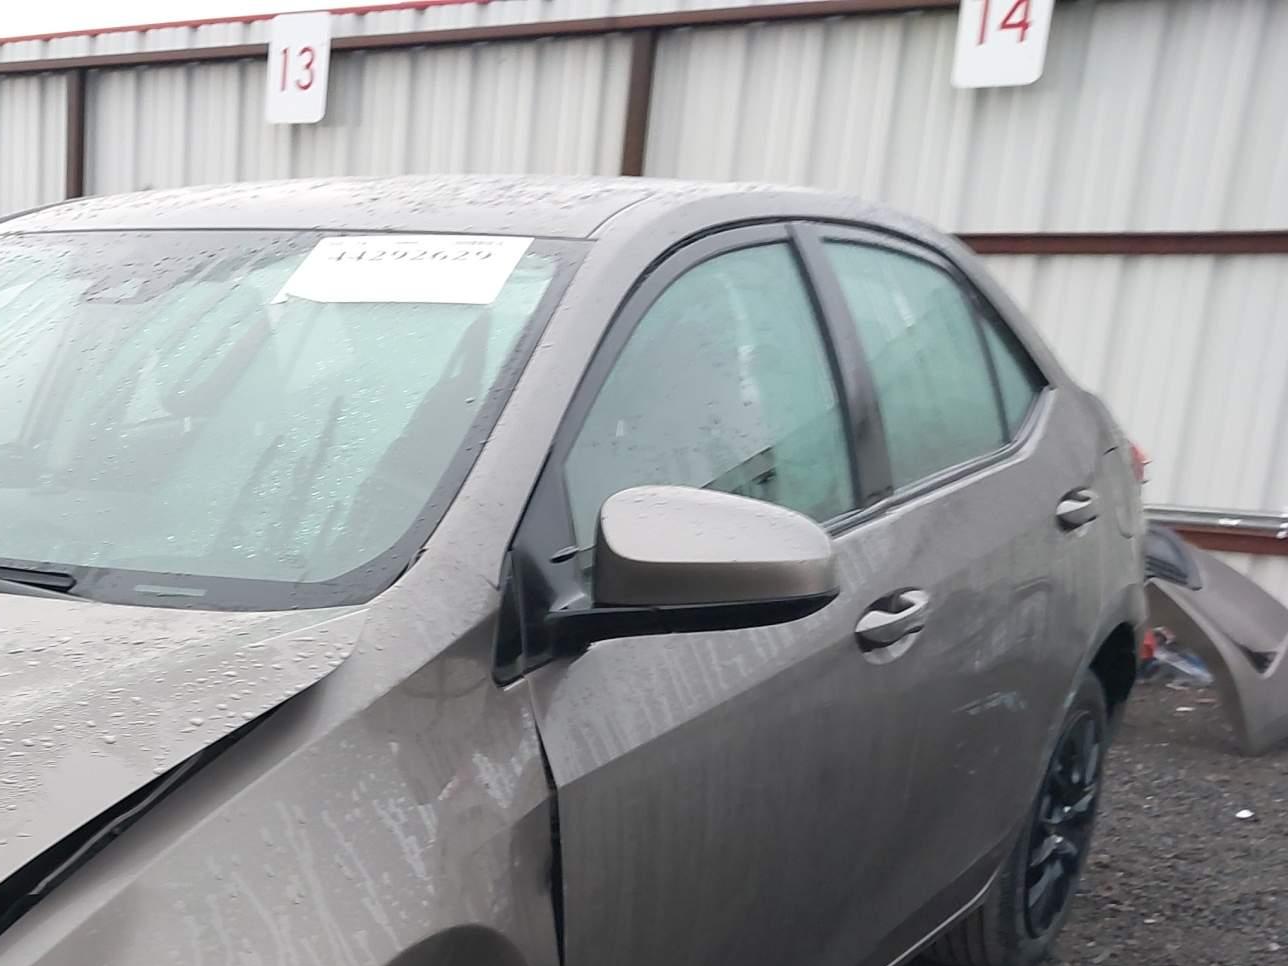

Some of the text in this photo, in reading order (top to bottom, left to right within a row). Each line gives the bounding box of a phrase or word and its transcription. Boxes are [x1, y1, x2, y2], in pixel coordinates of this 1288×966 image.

[977, 0, 1031, 45] 14
[280, 46, 316, 91] 13
[327, 249, 493, 262] 44292629
